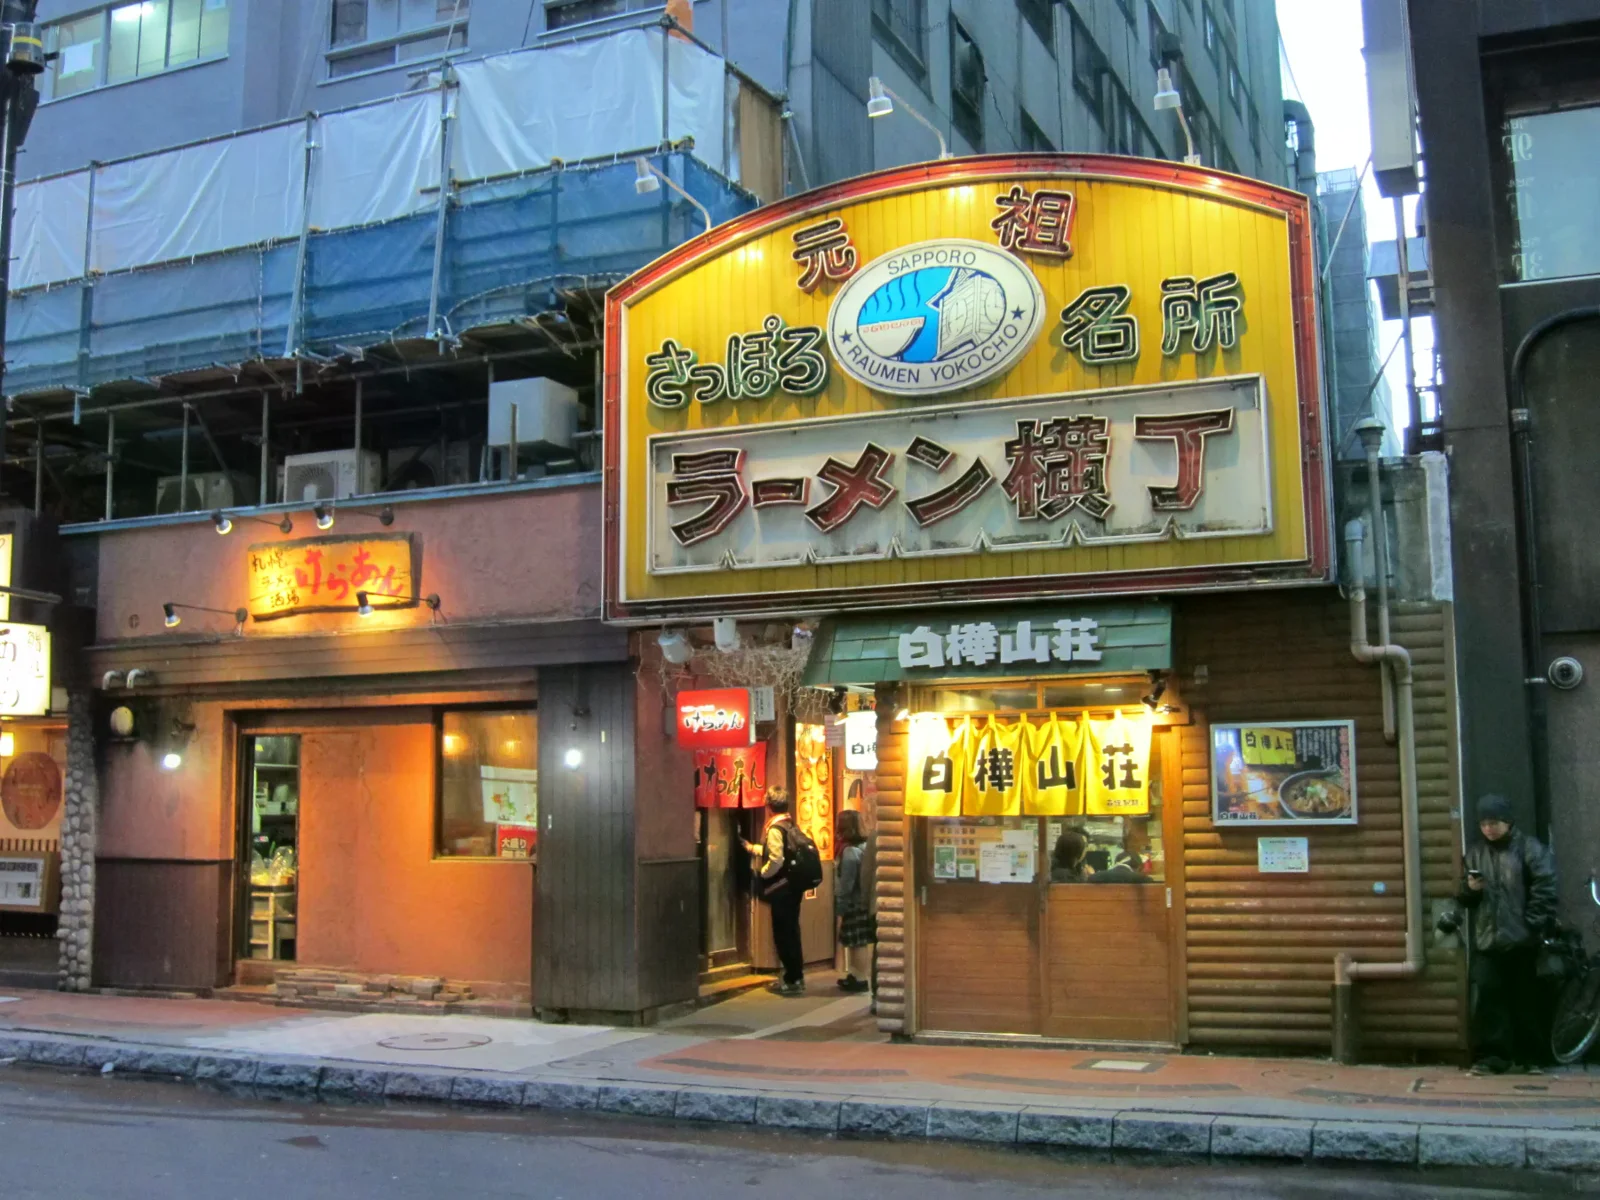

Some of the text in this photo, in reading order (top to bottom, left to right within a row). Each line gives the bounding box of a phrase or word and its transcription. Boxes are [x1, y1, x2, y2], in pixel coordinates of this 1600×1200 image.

[887, 249, 977, 275] SAPPORO
[645, 270, 1243, 409] さっぽろ 名所
[847, 324, 1018, 383] RAUMEN YOKOCHO
[665, 406, 1235, 547] ラーメン横丁
[898, 617, 1103, 669] 白樺山荘
[921, 743, 1142, 794] 白樺山荘
